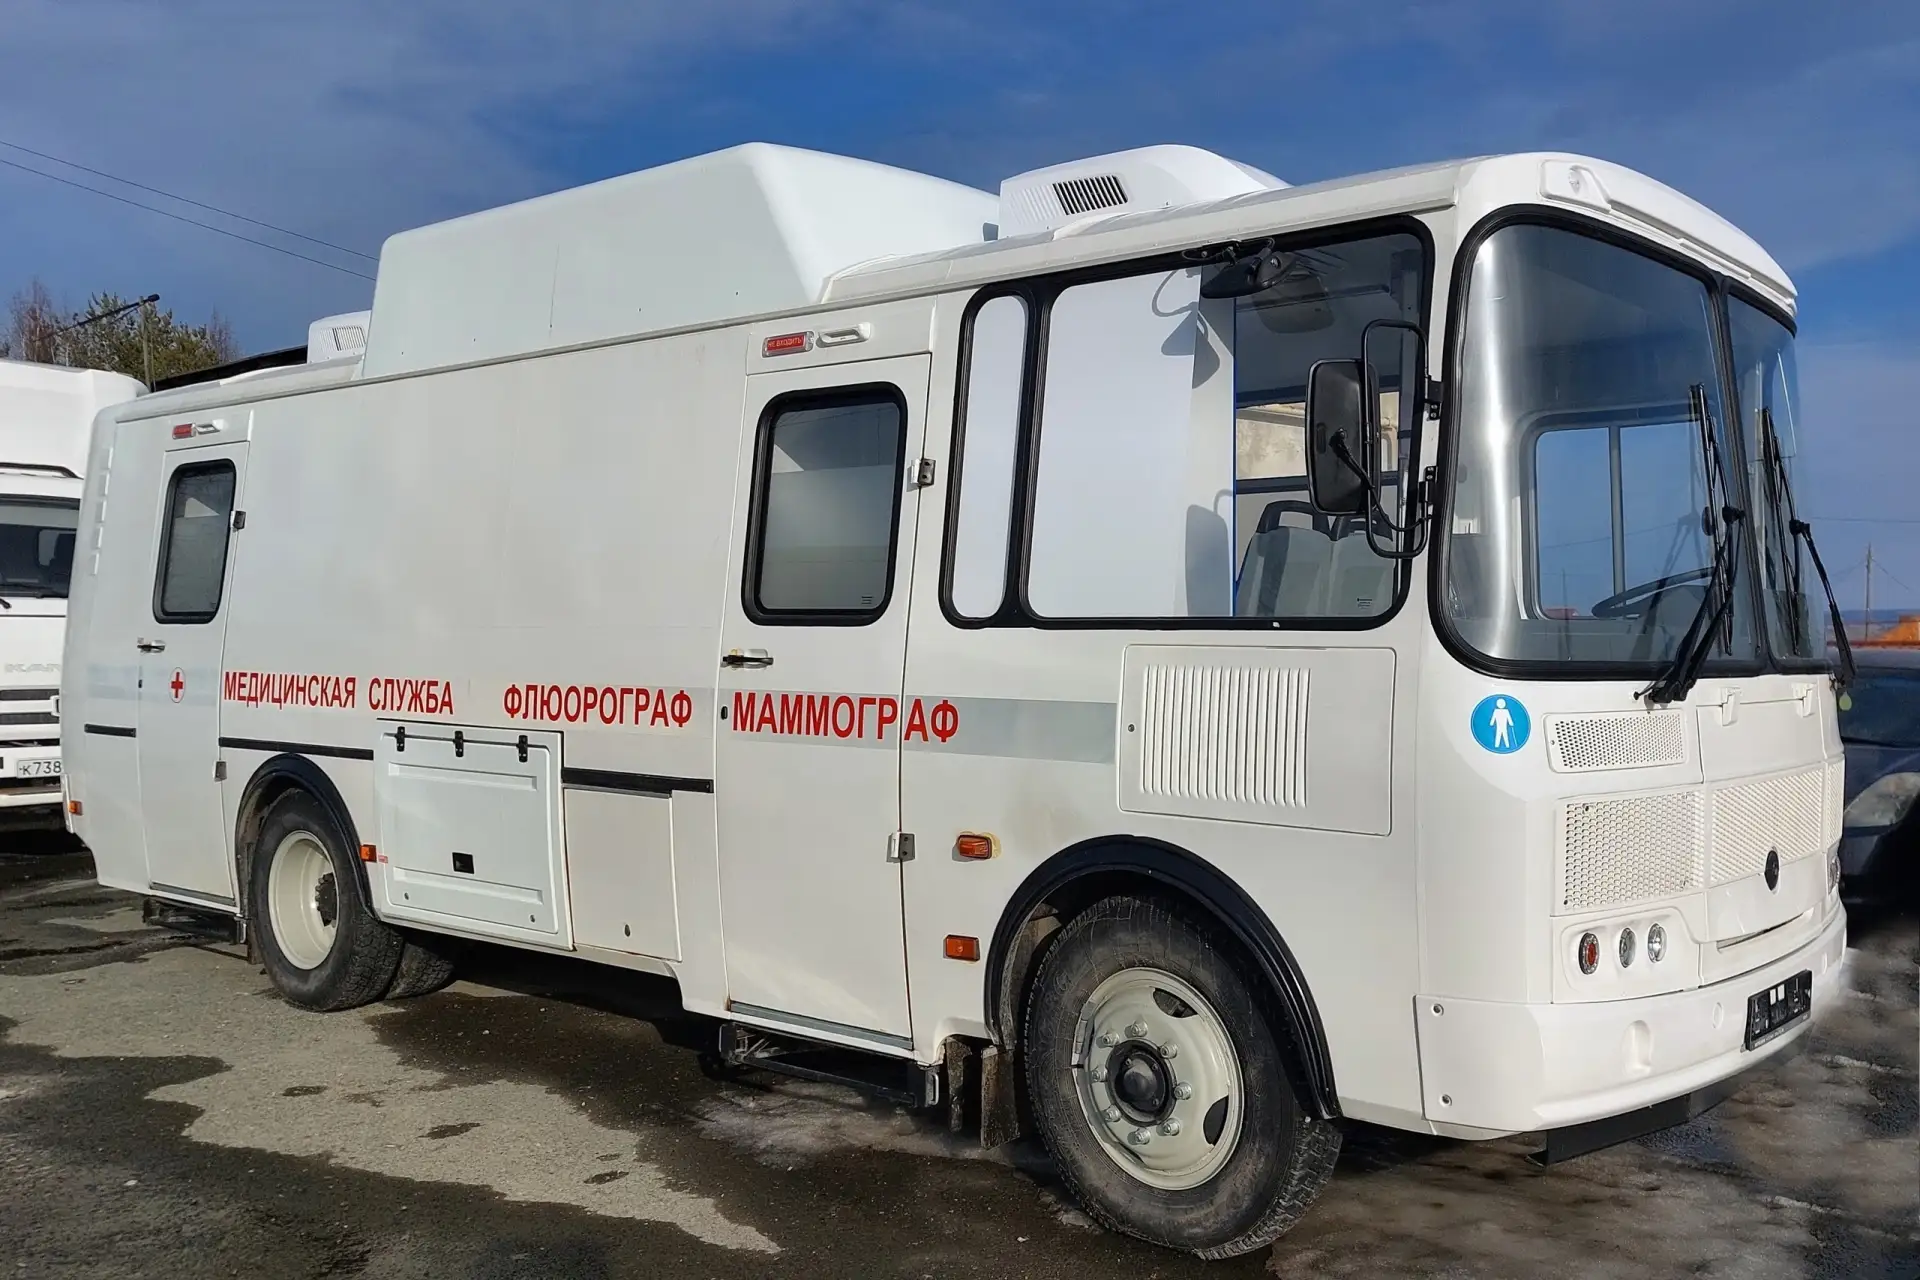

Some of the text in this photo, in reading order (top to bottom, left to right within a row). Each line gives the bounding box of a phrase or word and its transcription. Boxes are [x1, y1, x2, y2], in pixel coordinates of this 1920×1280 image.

[224, 671, 959, 743] МЕДИЦИНСКАЯ СЛУЖБА ФЛЮОРОГРАФ МАММОГРАФ
